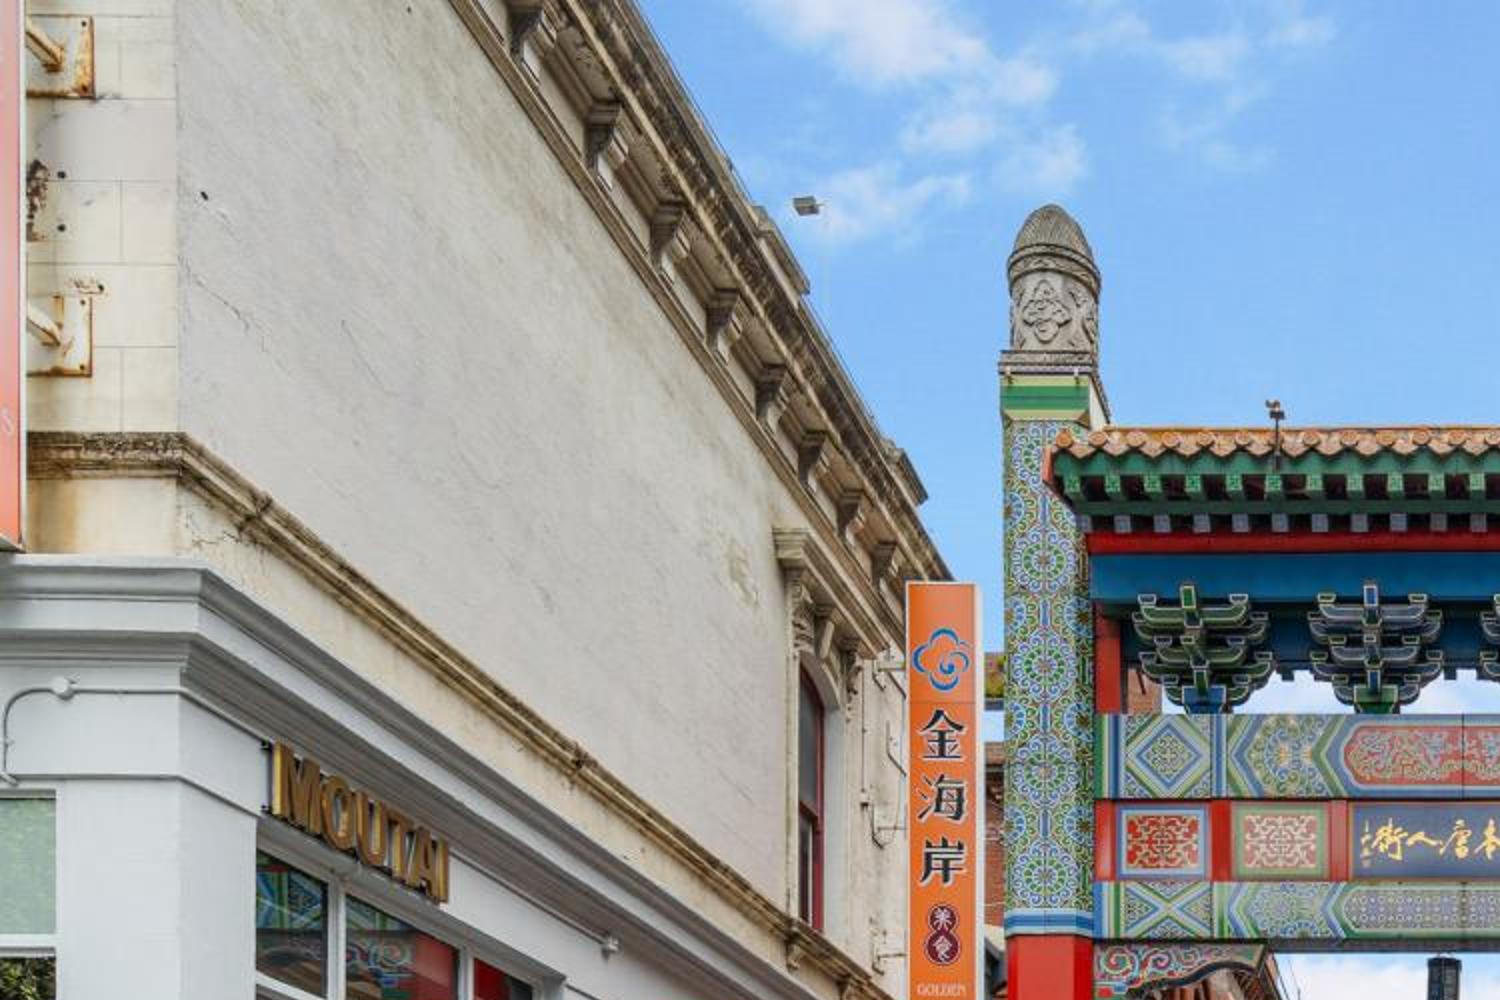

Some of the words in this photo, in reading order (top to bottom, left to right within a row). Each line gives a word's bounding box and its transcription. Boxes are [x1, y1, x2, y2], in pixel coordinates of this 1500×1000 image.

[271, 741, 448, 903] MOUTAI
[917, 707, 968, 888] 金海岸
